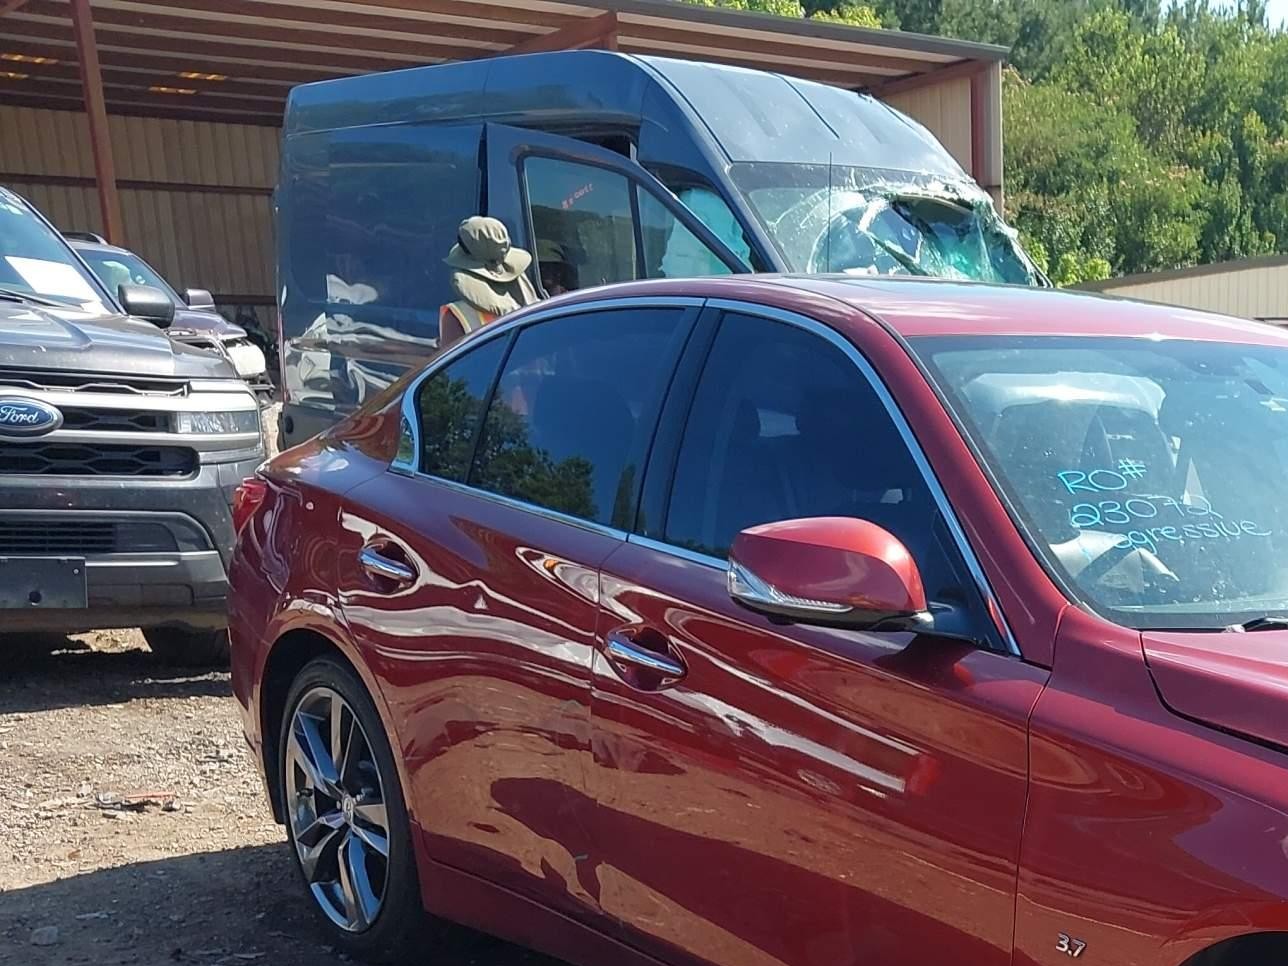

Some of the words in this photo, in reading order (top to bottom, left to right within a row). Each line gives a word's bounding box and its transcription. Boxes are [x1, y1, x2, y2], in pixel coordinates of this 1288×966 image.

[0, 405, 40, 423] Ford
[1057, 457, 1147, 495] RO#
[1071, 494, 1223, 527] 23072
[1055, 933, 1086, 957] 3.7
